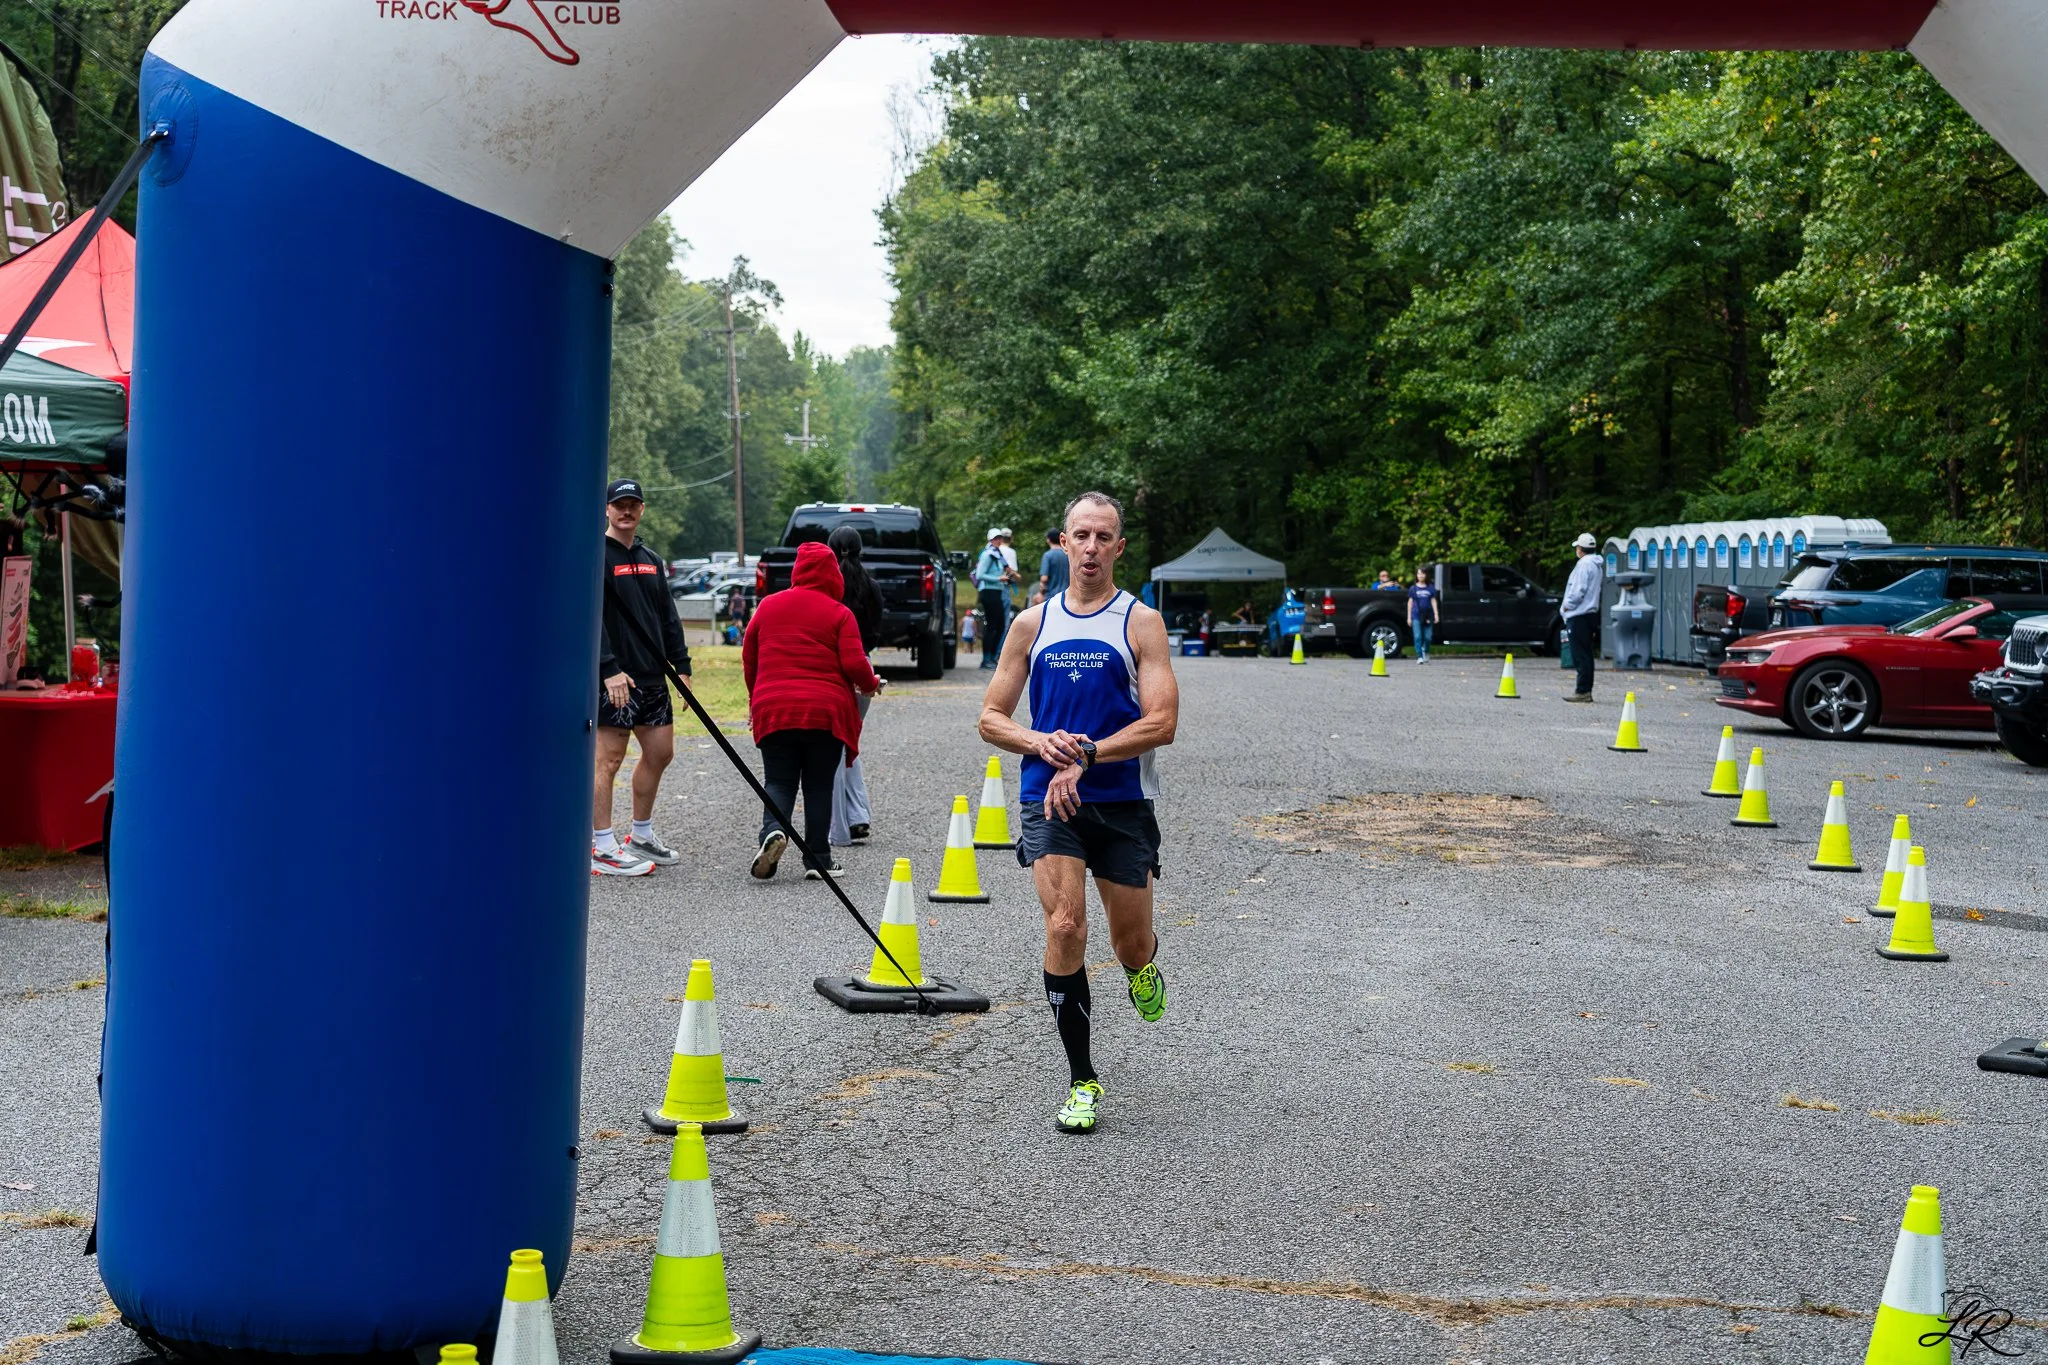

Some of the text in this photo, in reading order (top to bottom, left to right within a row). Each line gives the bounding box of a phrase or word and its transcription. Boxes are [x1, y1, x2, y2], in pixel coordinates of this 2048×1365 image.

[376, 0, 621, 25] TRACK CLUB
[0, 392, 57, 445] OM
[1044, 652, 1110, 662] PILGRIMAGE
[1048, 660, 1104, 669] TRACK CLUB
